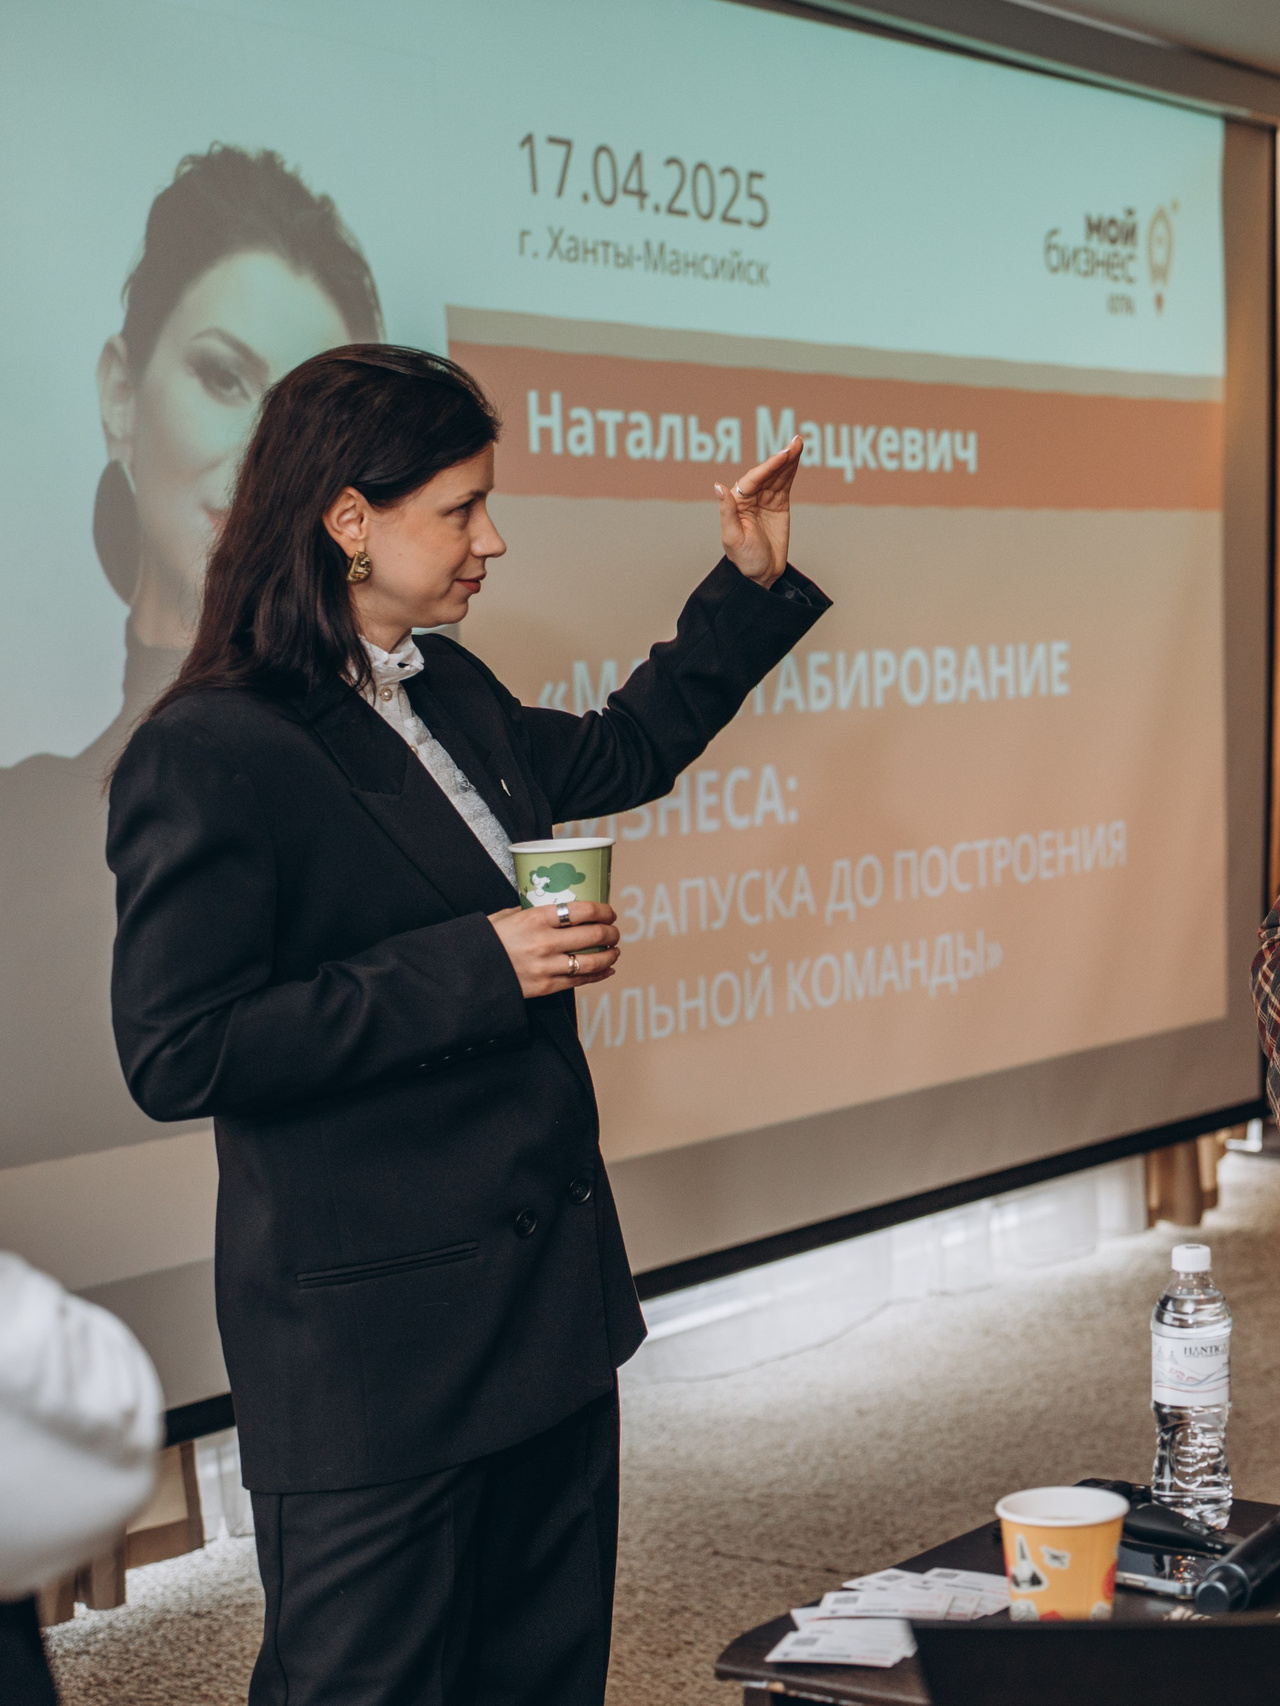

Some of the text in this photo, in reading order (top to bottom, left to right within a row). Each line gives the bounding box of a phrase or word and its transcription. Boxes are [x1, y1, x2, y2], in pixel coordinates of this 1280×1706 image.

[518, 132, 769, 229] 17.04.2025
[518, 225, 770, 288] г. Ханты-Мансийск
[1044, 227, 1136, 286] бизнес
[527, 390, 979, 483] Наталья Мацкевич
[619, 820, 1128, 943] ЗАПУСКА ДО ПОСТРОЕНИЯ
[579, 928, 1004, 1051] ИЛЬНОЙ КОМАНДЫ»
